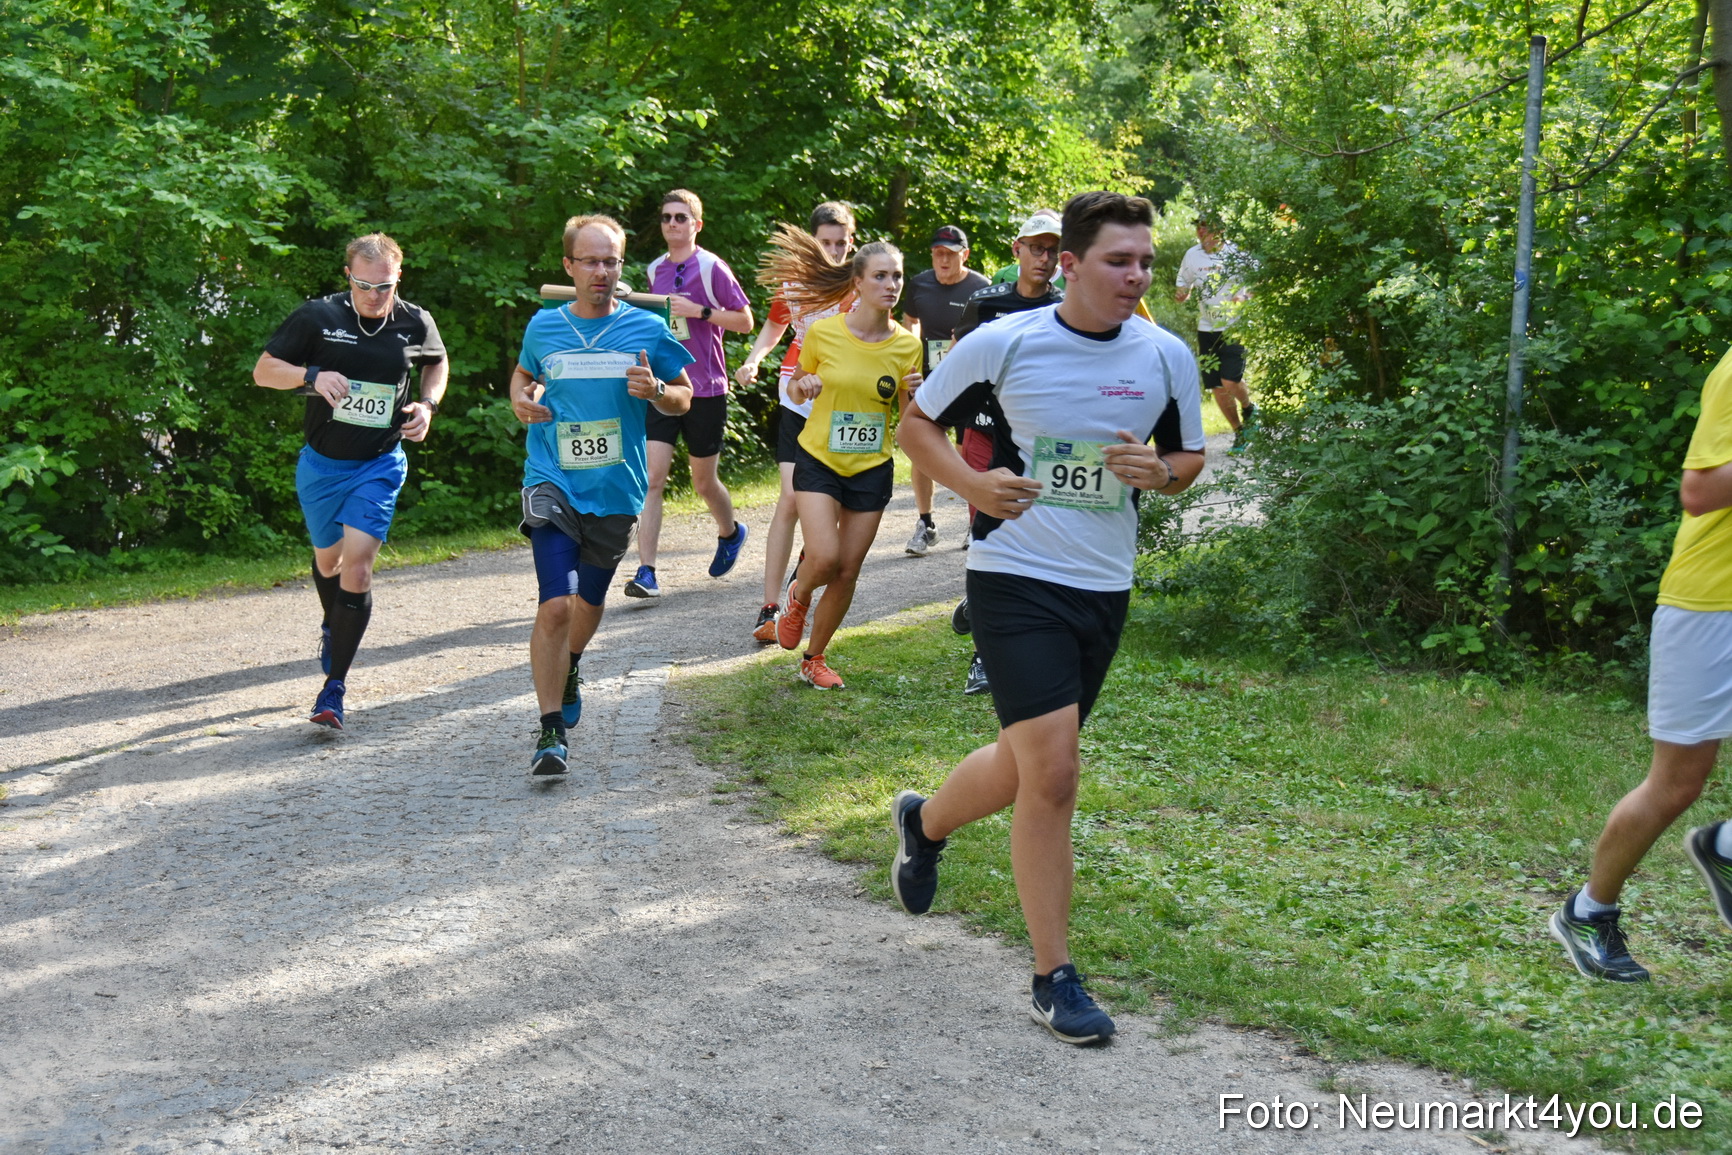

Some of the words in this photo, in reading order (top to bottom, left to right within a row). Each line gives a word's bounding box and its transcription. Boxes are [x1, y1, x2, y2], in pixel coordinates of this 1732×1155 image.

[342, 395, 386, 415] 2403
[838, 426, 877, 442] 1763
[571, 437, 608, 456] 838
[1051, 464, 1103, 492] 961
[1050, 488, 1077, 498] Mandel
[1079, 491, 1104, 500] Marius
